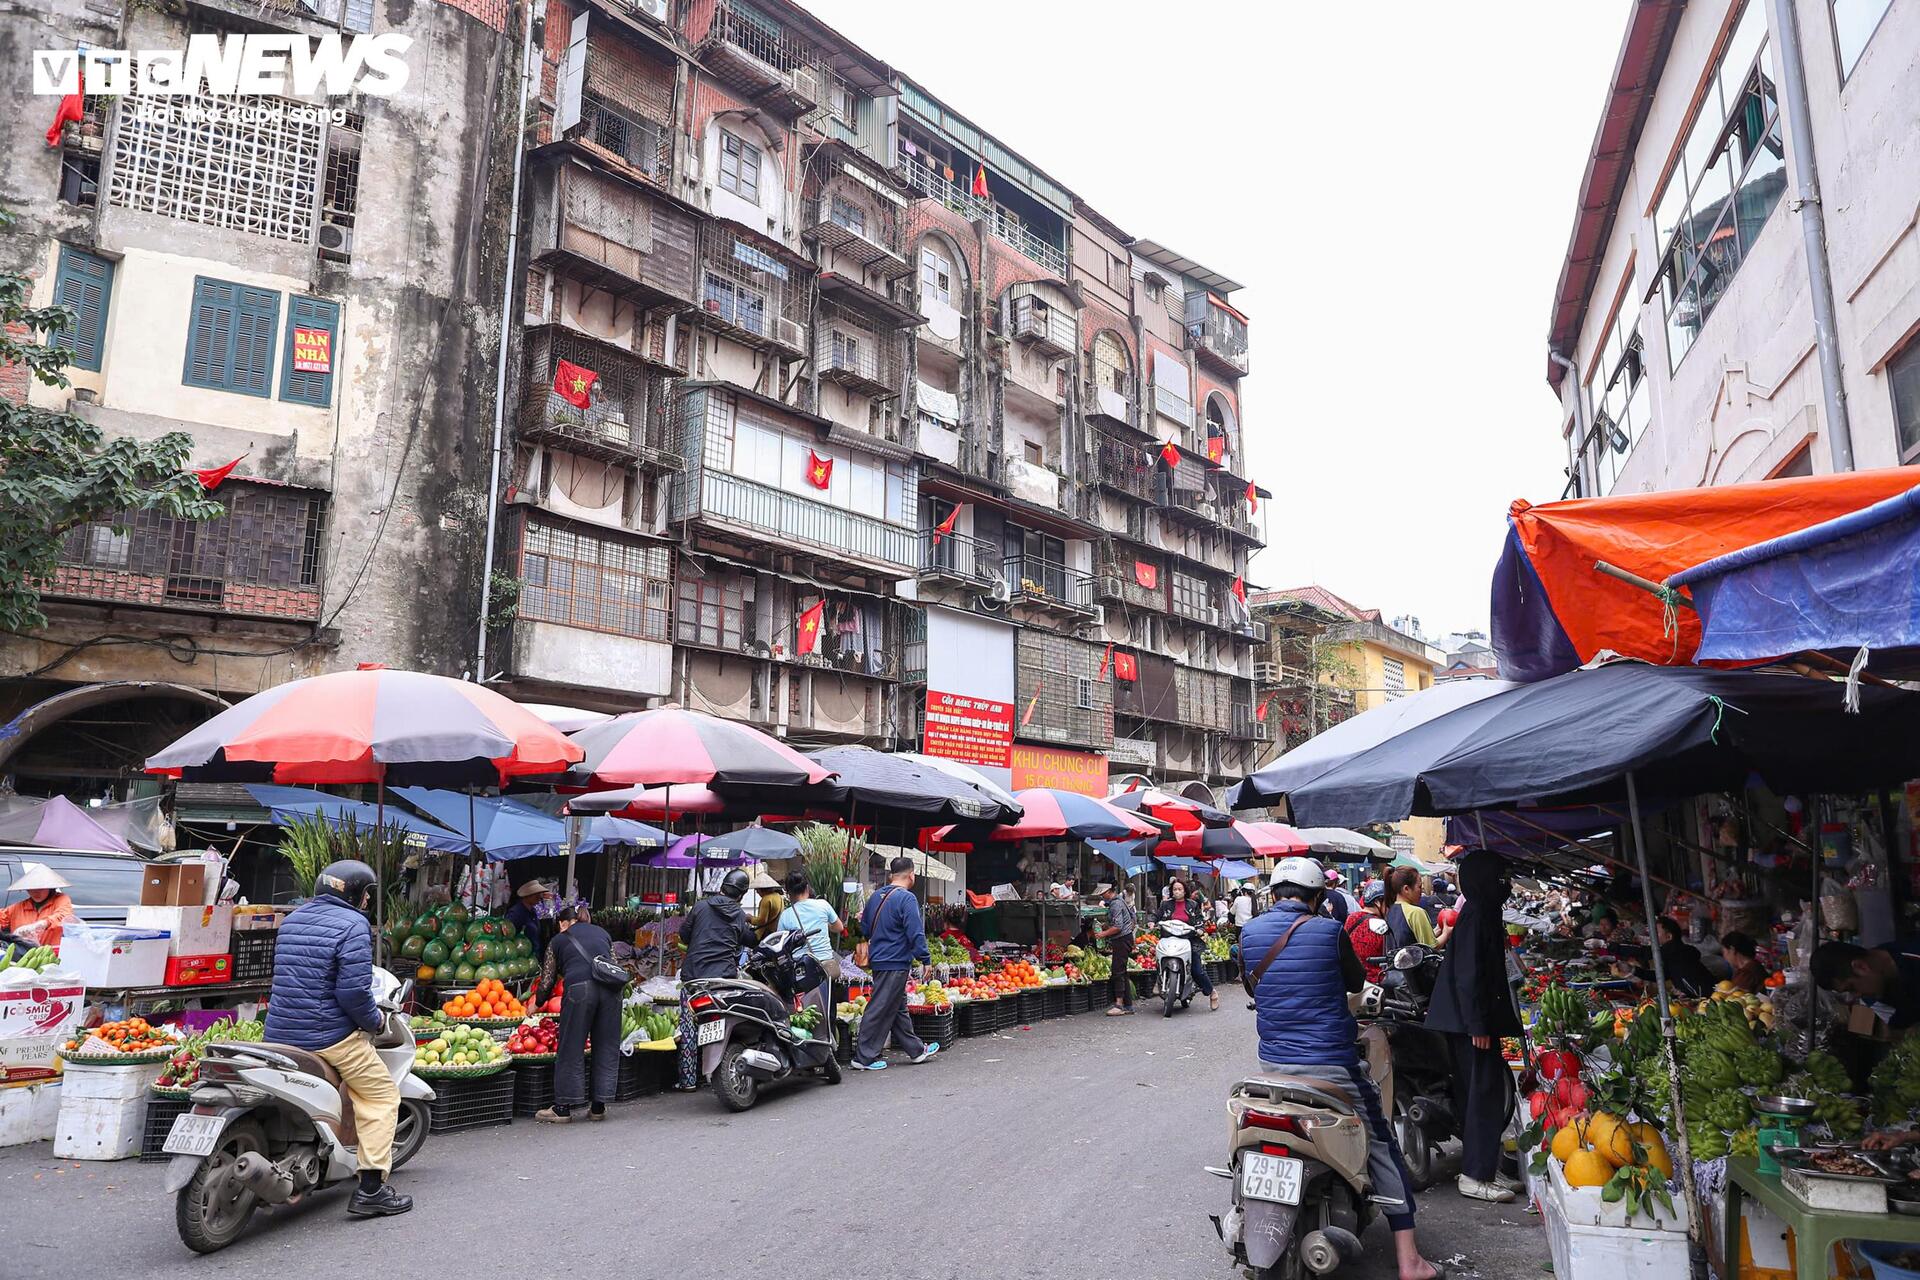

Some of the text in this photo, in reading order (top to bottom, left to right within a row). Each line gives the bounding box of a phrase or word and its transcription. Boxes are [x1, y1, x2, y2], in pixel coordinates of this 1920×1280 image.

[296, 331, 328, 347] BÁN
[296, 347, 329, 362] NHÀ
[1013, 750, 1040, 769] KHU
[1042, 753, 1083, 774] CHUNG
[22, 1052, 48, 1060] PEARS
[179, 1118, 216, 1135] 29-N1
[168, 1134, 214, 1151] 306.07
[1251, 1156, 1293, 1179] 29-D2
[1245, 1176, 1297, 1200] 479.67
